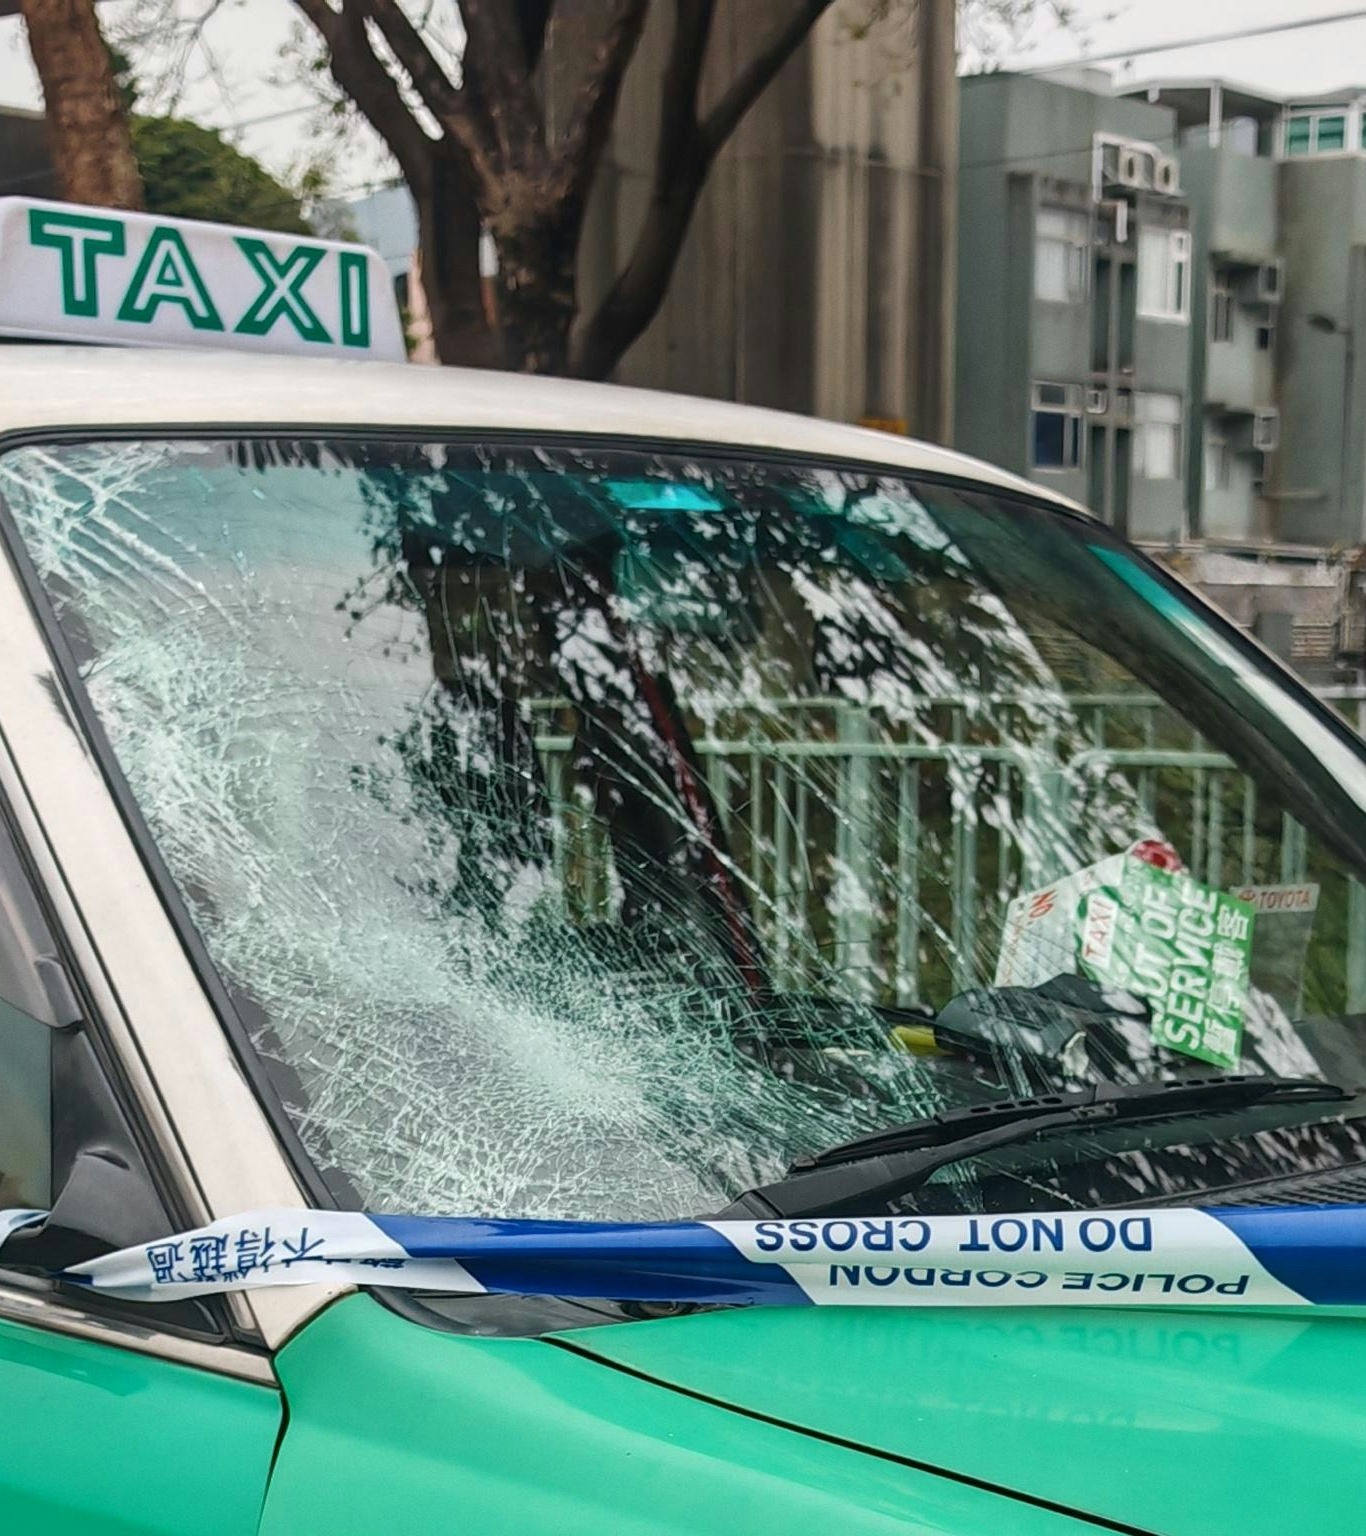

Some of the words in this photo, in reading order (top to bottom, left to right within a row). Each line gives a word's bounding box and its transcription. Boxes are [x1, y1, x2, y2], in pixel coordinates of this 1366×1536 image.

[29, 208, 370, 347] TAXI
[1140, 884, 1178, 941] OF
[1259, 890, 1311, 909] TOYOTA
[1085, 896, 1114, 957] TAXI
[1163, 879, 1218, 1050] SERVICE
[755, 1219, 932, 1253] CROSS
[959, 1217, 1064, 1252] NOT
[1078, 1216, 1152, 1252] DO
[829, 1263, 1049, 1289] CORDON
[1063, 1270, 1251, 1296] POLICE
